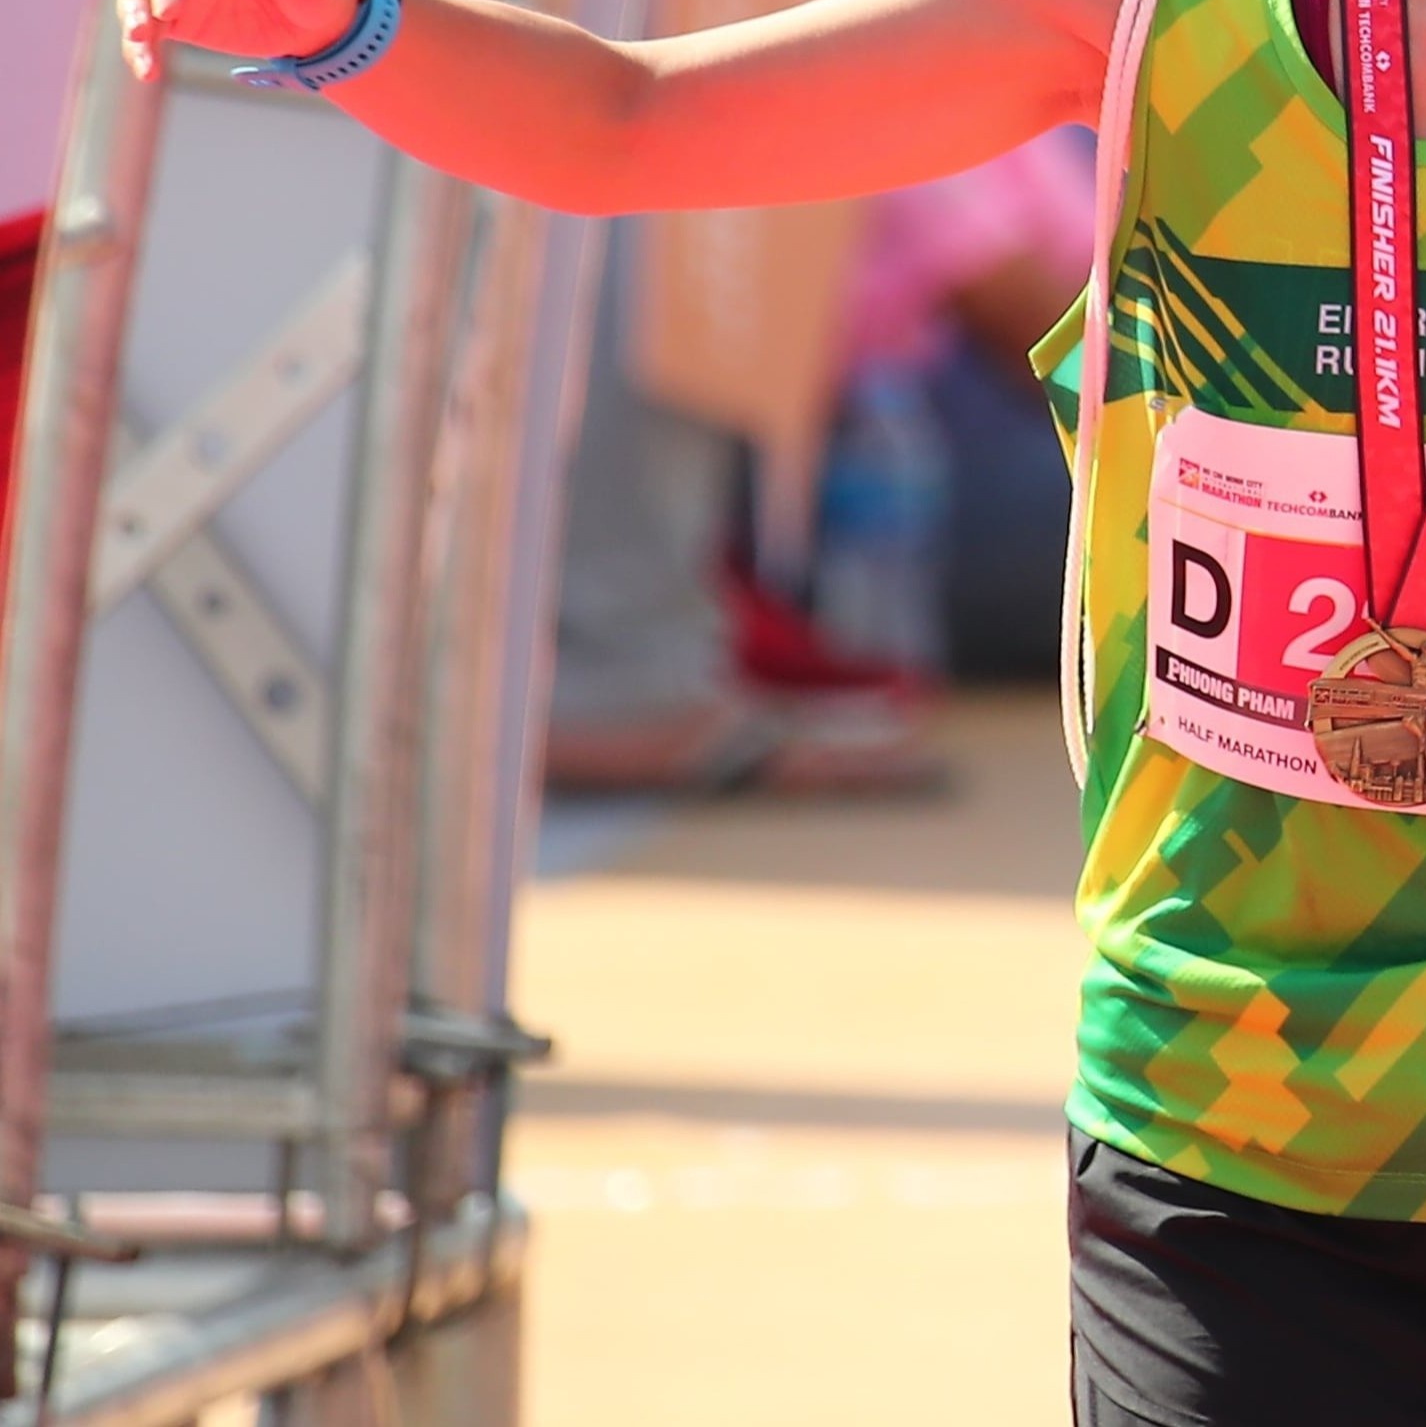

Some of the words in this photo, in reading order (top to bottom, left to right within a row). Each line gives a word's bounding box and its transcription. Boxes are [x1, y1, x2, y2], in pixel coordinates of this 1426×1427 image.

[1358, 11, 1376, 113] TECHCOMBANK
[1370, 134, 1397, 302] FINISHER
[1373, 309, 1401, 429] 21.1KM
[1202, 482, 1262, 509] MARATHON
[1171, 539, 1232, 639] D
[1178, 716, 1214, 742] HALF
[1218, 734, 1318, 775] MARATHON
[1237, 687, 1295, 720] PHAM
